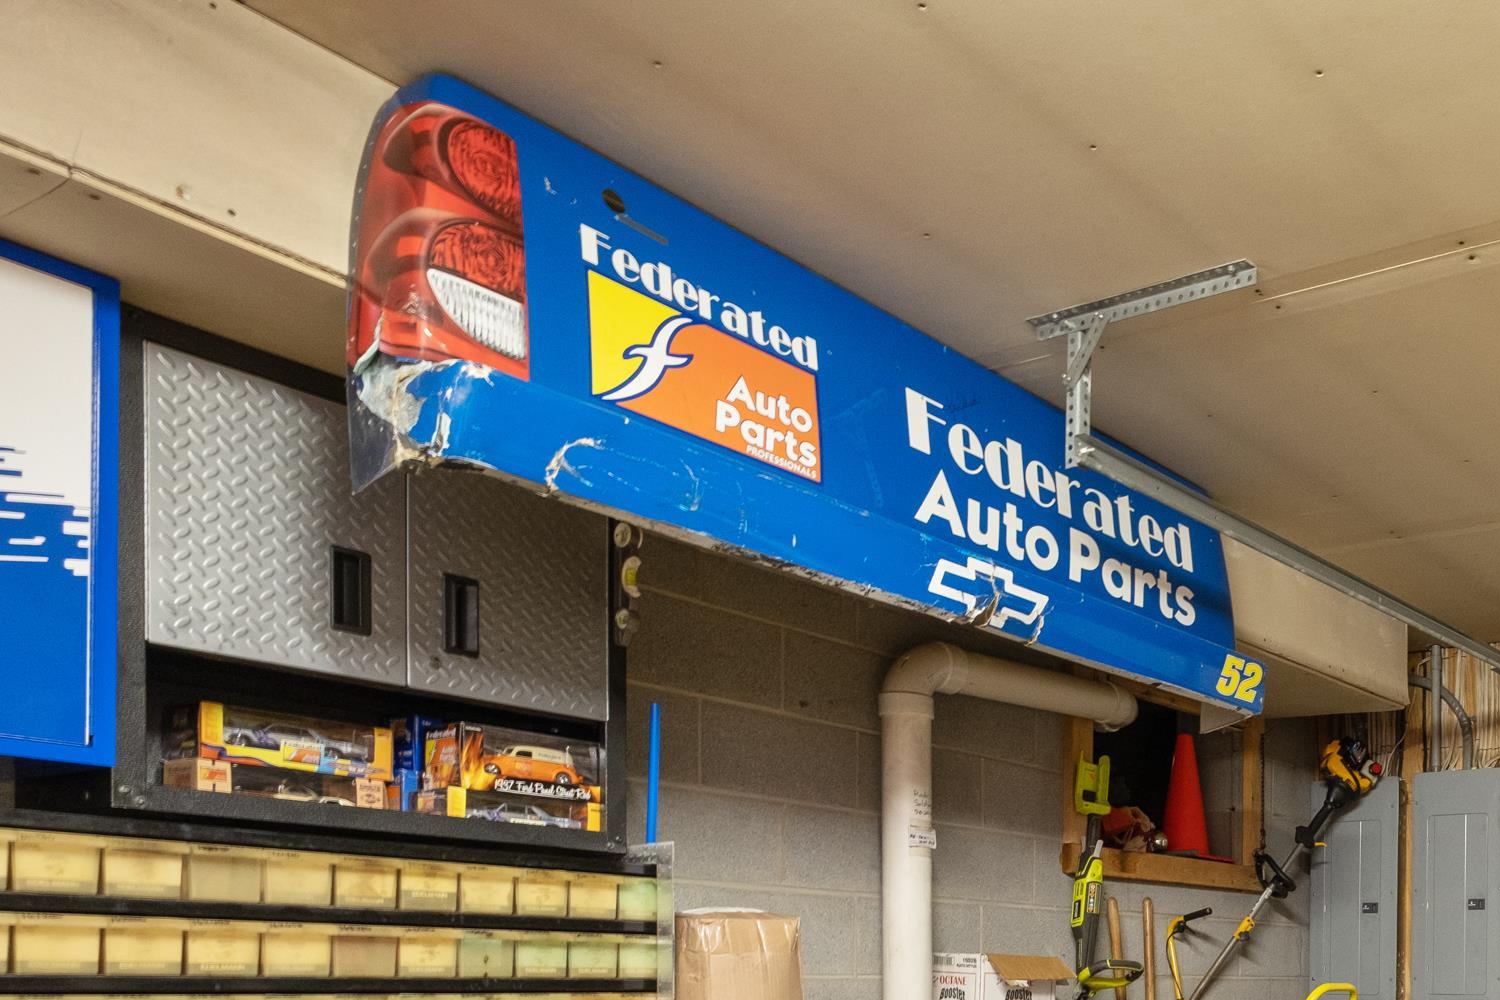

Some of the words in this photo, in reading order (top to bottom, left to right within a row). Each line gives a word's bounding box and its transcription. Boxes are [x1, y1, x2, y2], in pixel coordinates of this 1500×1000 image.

[579, 223, 819, 371] Federated
[726, 375, 813, 433] Auto
[716, 400, 817, 468] Parts
[746, 445, 818, 479] PROFESSIONALS
[905, 387, 1194, 573] Federated
[914, 469, 1060, 571] Auto
[1069, 527, 1196, 626] Parts
[1215, 654, 1264, 703] 52
[495, 779, 513, 791] 1937
[939, 975, 967, 986] OCTANE
